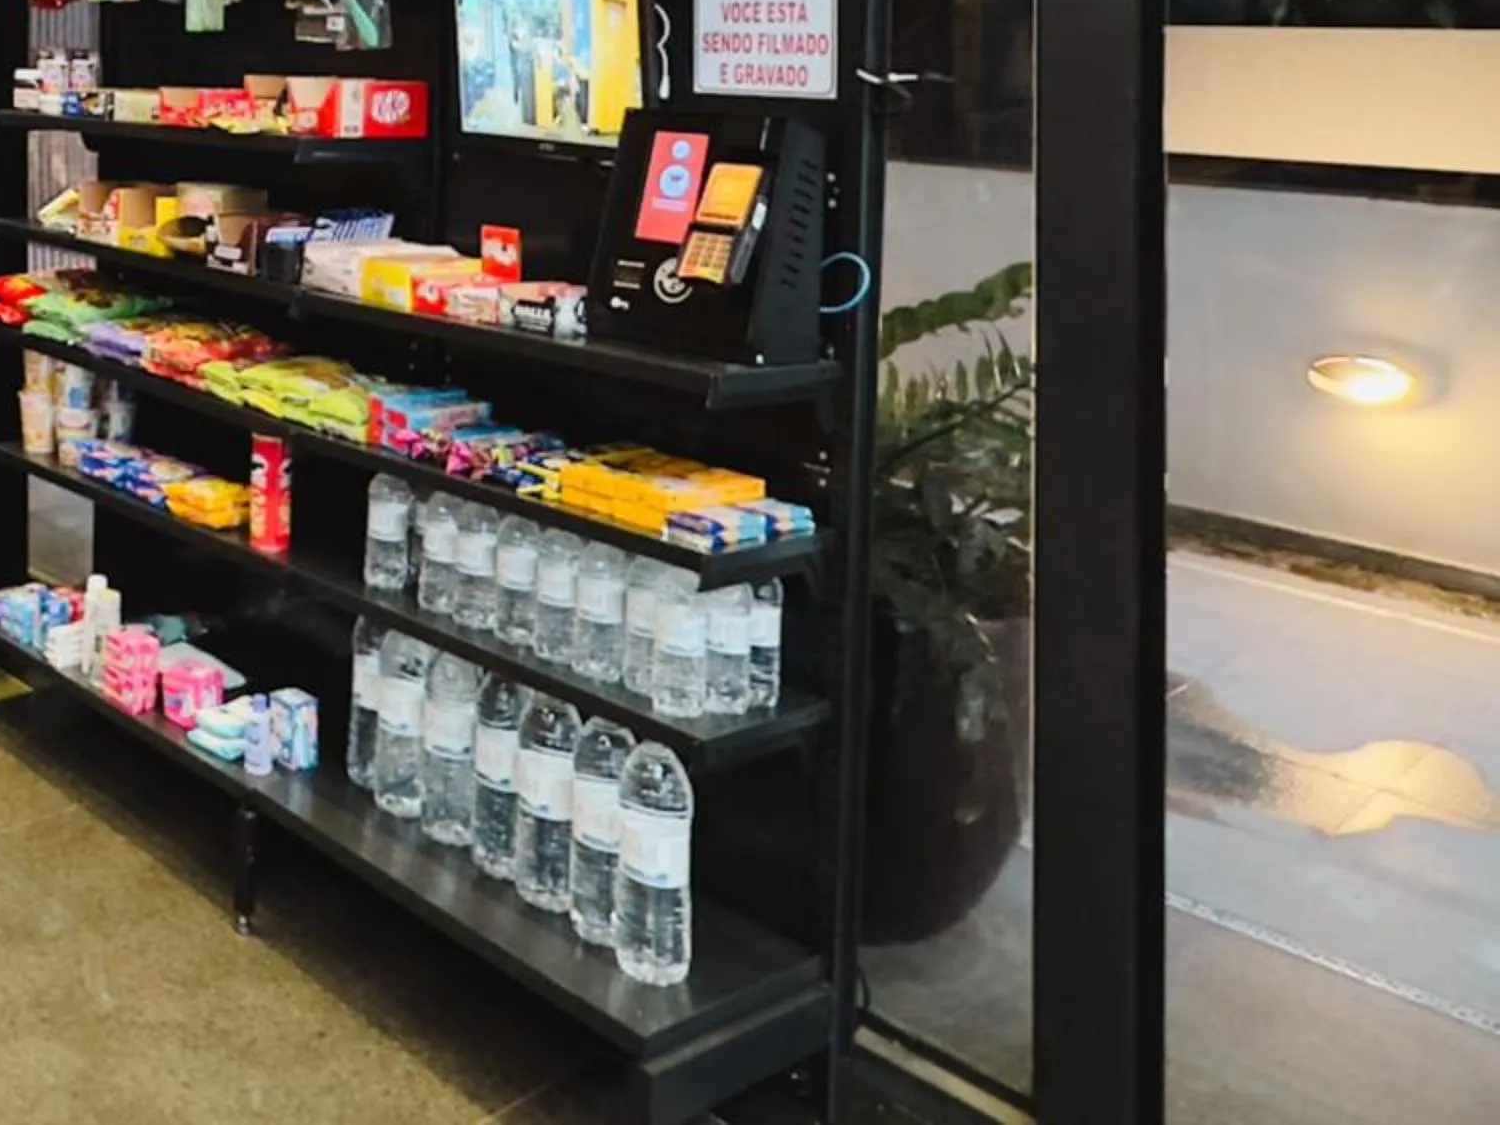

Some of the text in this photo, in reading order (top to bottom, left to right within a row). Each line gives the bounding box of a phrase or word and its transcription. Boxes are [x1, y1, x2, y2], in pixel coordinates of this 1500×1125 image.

[702, 31, 829, 56] SENDO FILMADO
[720, 62, 809, 87] E GRAVADO
